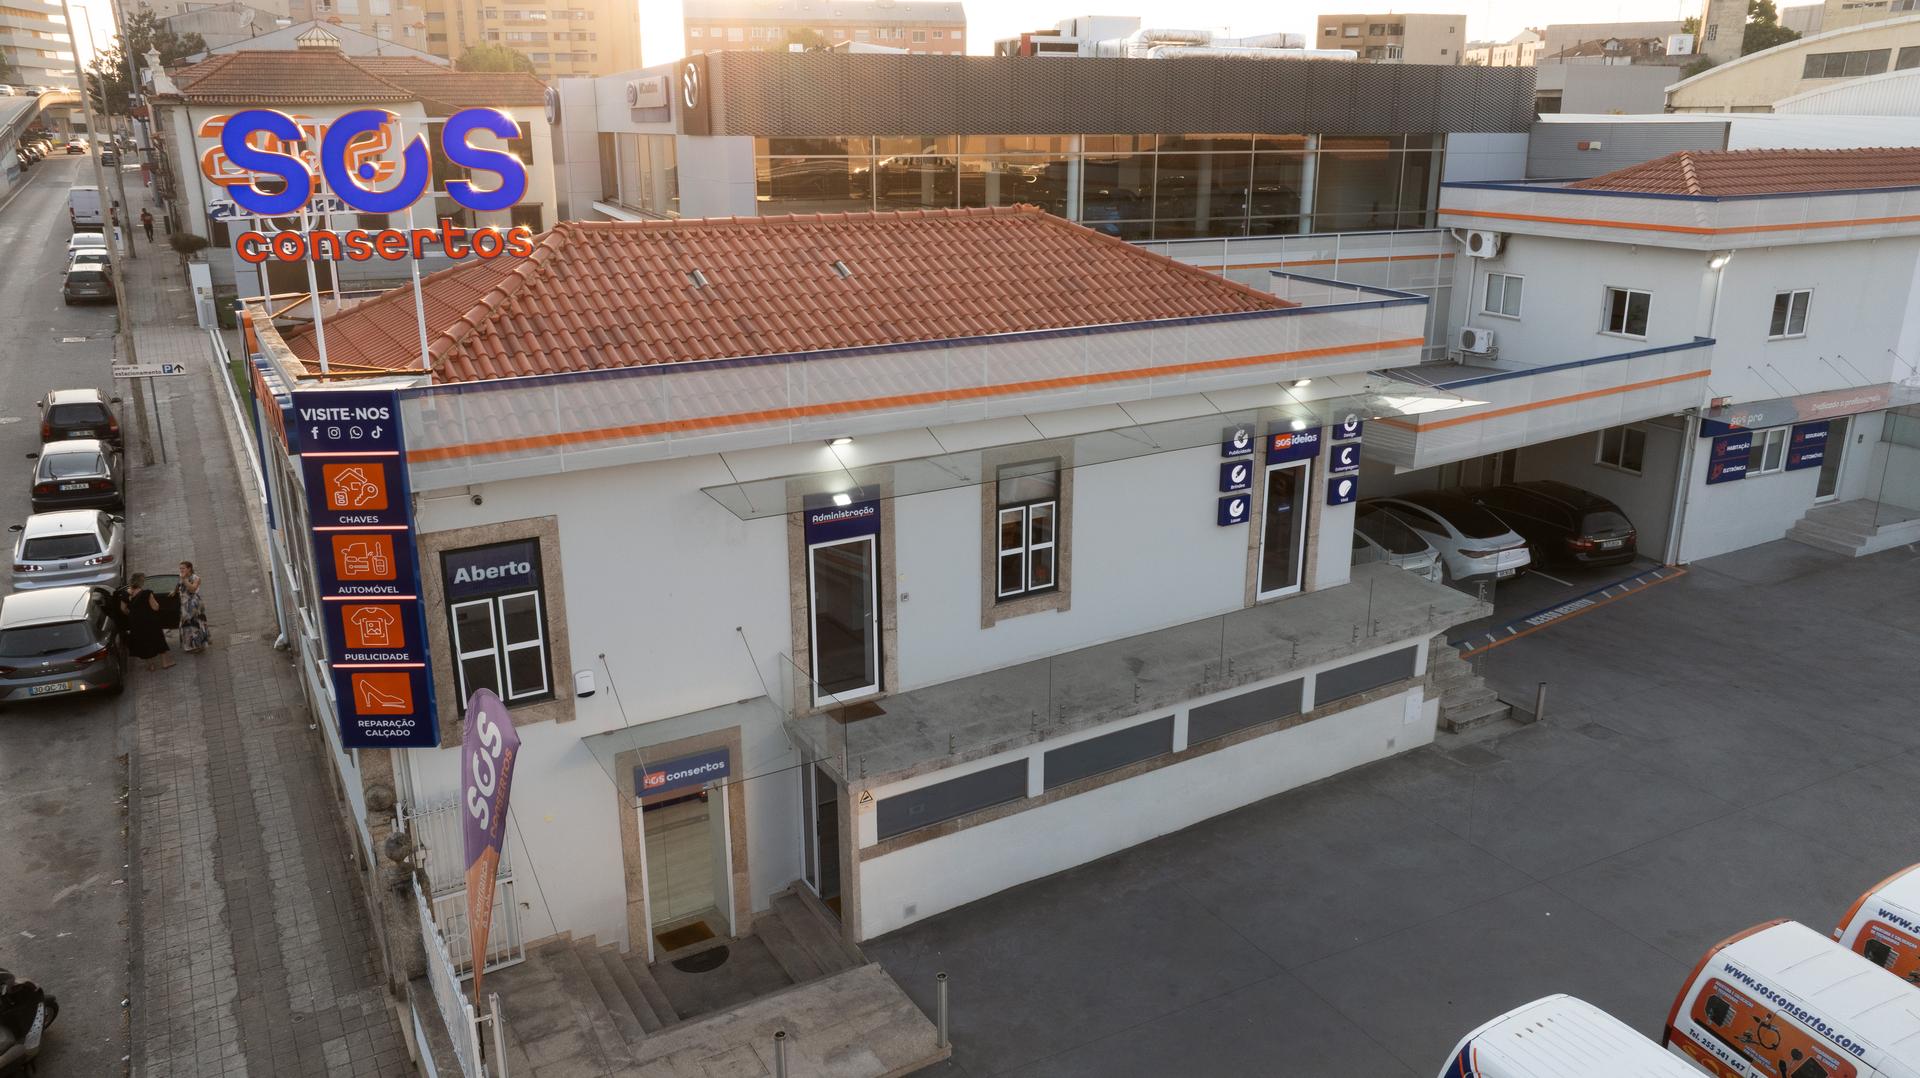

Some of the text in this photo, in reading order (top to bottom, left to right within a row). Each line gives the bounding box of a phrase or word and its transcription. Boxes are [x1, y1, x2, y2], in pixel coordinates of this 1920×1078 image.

[221, 108, 529, 215] SOS
[236, 217, 534, 264] consertos
[300, 407, 389, 421] VISITE-NOS
[1747, 413, 1763, 425] pro
[339, 515, 379, 524] CHAVES
[812, 506, 874, 523] Administração
[453, 561, 531, 584] Aberto
[338, 585, 399, 594] AUTOMÓVEL
[345, 653, 409, 661] PUBLICIDADE
[358, 719, 415, 729] REPARAÇÃO
[365, 729, 411, 738] CALÇADO
[467, 711, 502, 830] SOS
[666, 761, 725, 781] consertos
[1724, 963, 1866, 1057] www.sosconsertos.com
[1688, 1028, 1700, 1041] Tel.
[1702, 1038, 1715, 1051] 255
[1716, 1049, 1730, 1061] 341
[1730, 1060, 1745, 1071] 647
